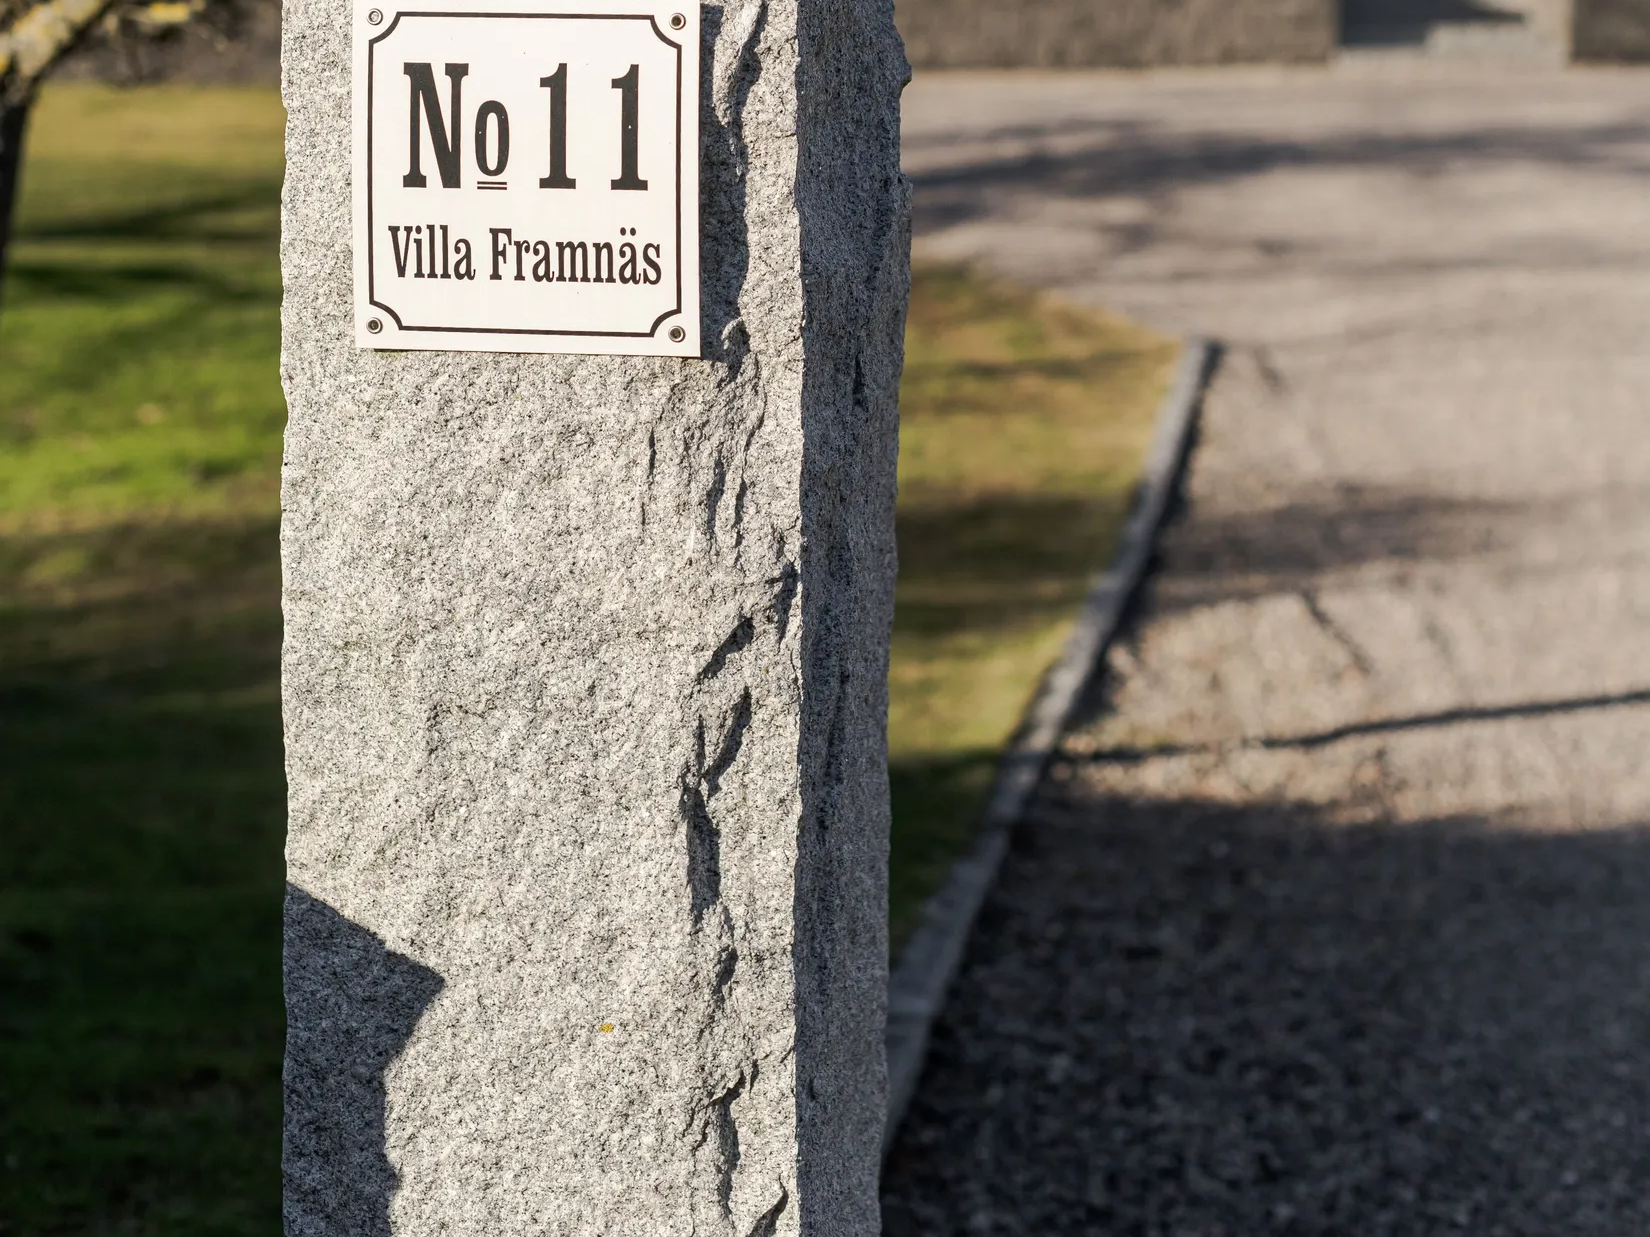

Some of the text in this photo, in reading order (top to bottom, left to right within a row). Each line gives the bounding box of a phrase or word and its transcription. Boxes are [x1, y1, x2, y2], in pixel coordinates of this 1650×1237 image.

[402, 62, 649, 191] No 11
[387, 224, 662, 285] Villa Framnäs
